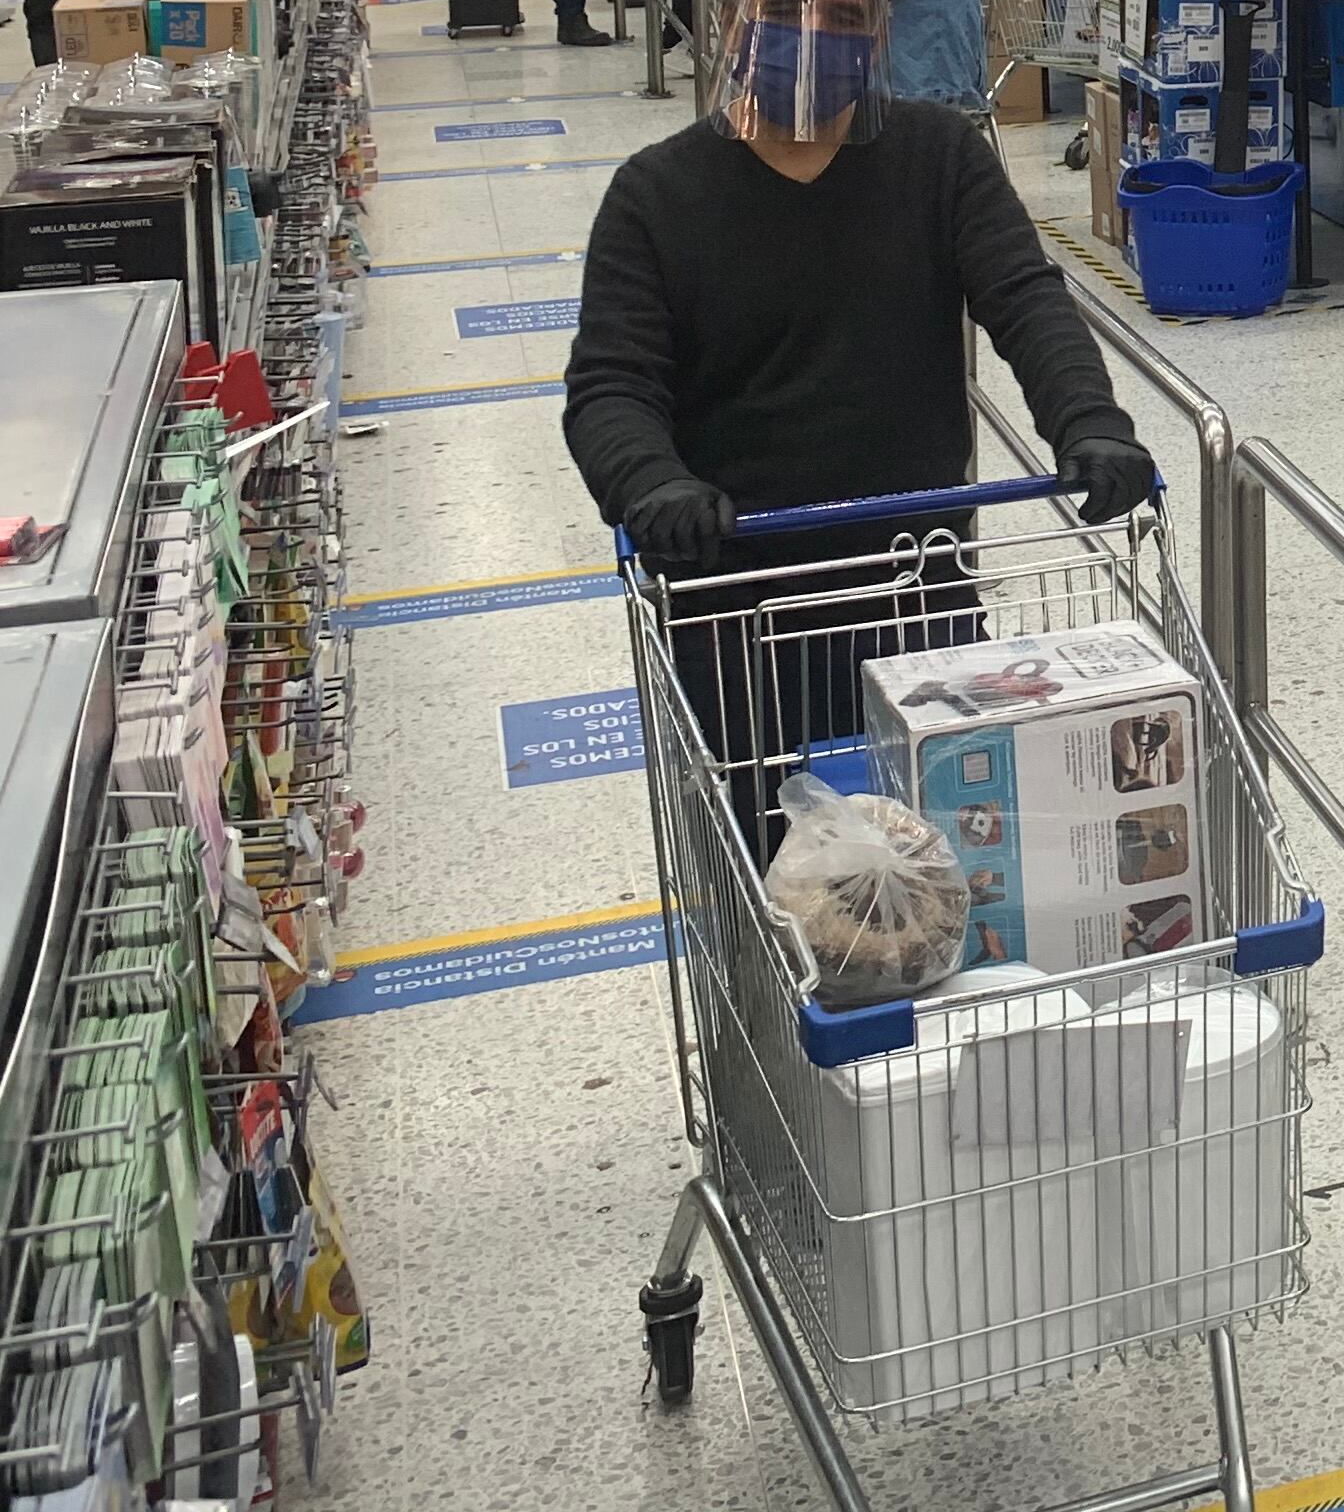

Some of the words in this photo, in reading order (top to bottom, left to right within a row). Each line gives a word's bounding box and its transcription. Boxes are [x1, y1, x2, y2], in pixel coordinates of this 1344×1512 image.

[186, 9, 202, 44] Pack
[66, 35, 78, 56] LED
[67, 222, 98, 232] BLACK
[100, 220, 122, 230] AND
[123, 218, 153, 228] WHITE
[377, 599, 488, 618] Distancia
[523, 737, 576, 756] LOS
[587, 731, 625, 746] EN
[538, 939, 656, 966] Mantén
[374, 961, 527, 996] Distancia
